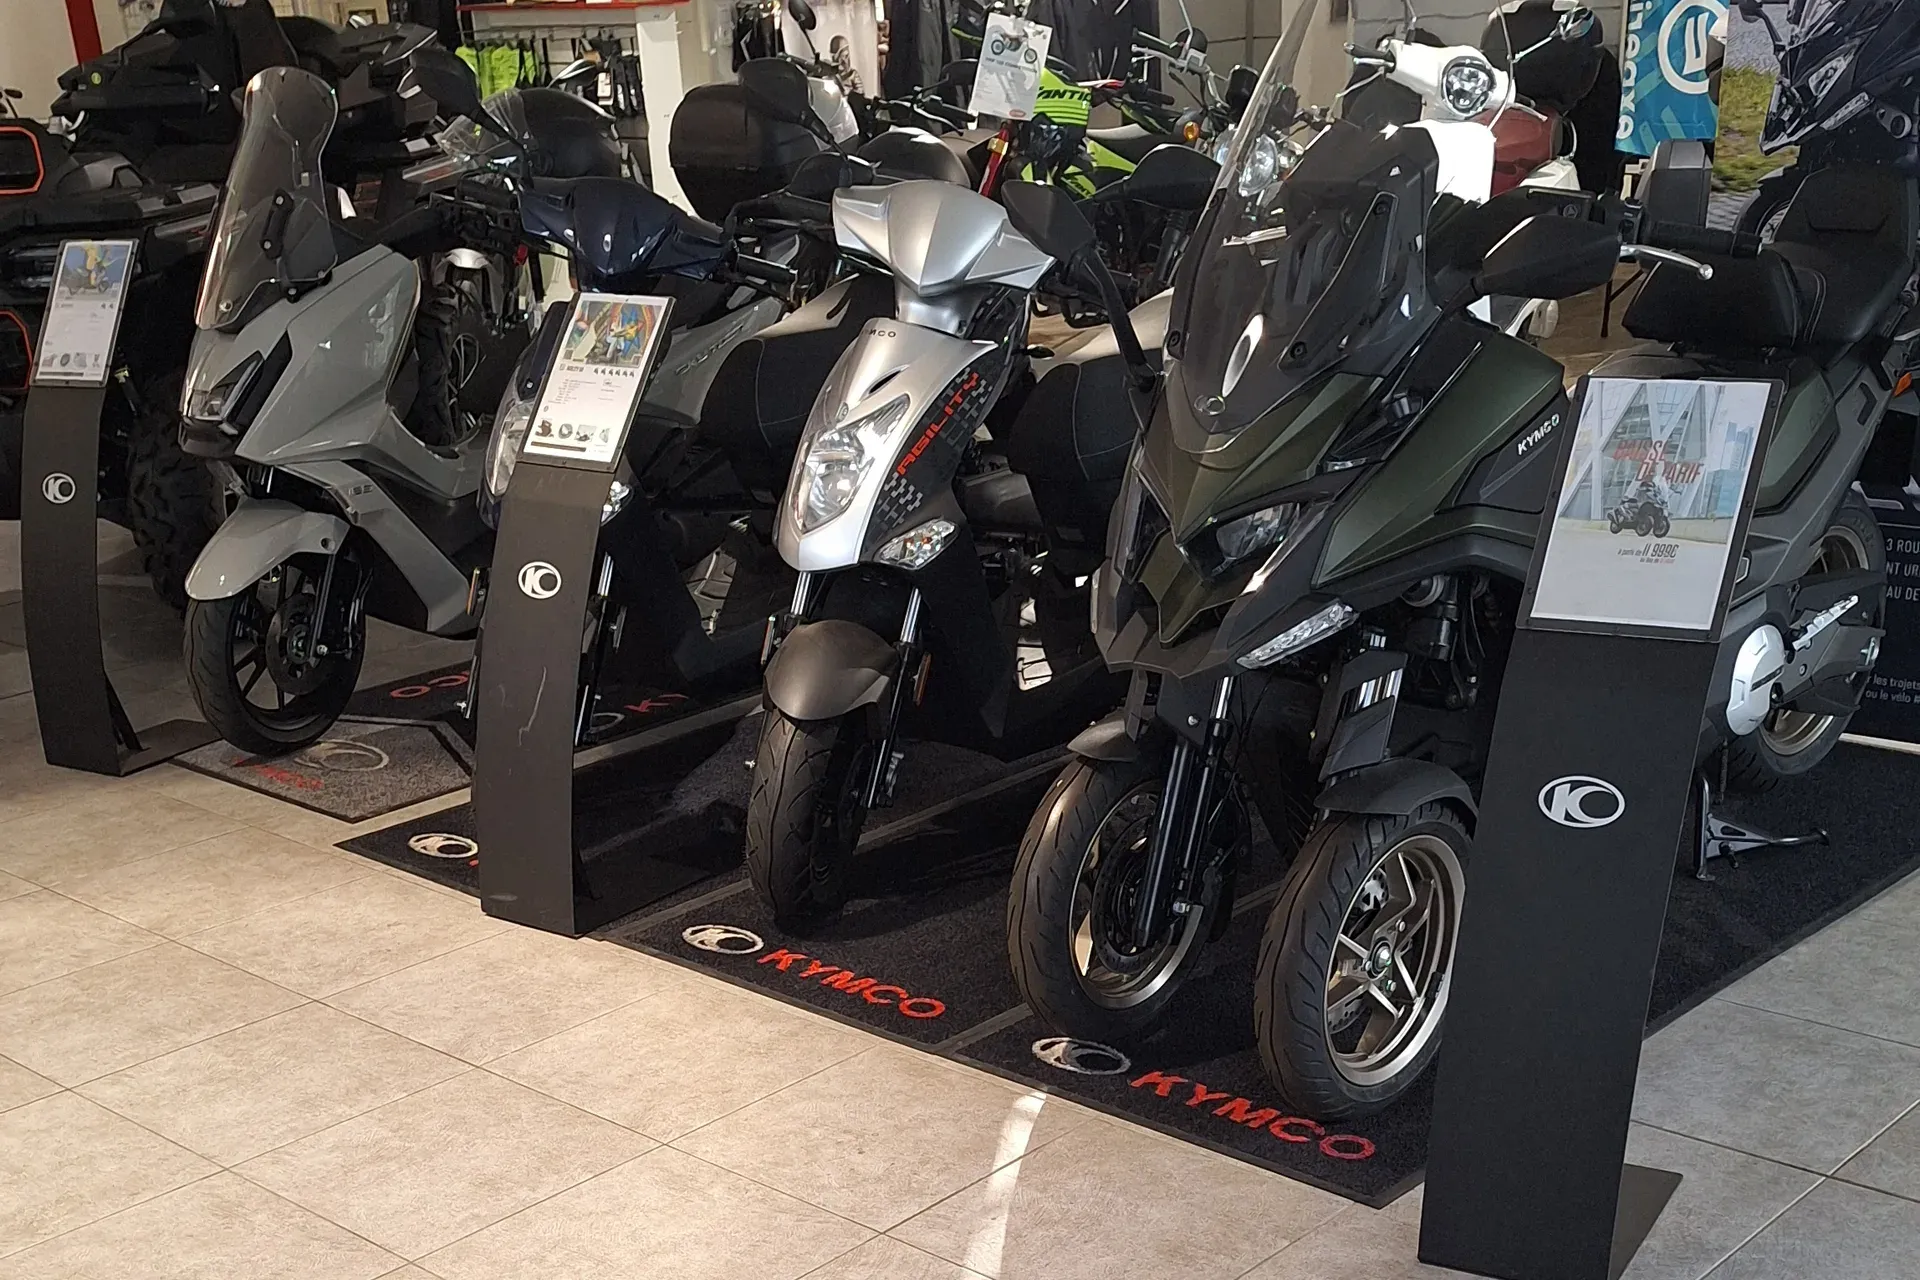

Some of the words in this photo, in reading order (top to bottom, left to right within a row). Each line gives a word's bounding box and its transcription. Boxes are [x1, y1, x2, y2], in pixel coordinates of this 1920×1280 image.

[897, 372, 979, 475] AGILITY
[1518, 413, 1560, 455] KYMCO
[1886, 538, 1893, 552] 3
[1904, 563, 1920, 578] UR
[1886, 585, 1902, 599] AU
[1873, 673, 1887, 687] les
[1865, 689, 1878, 699] ou
[1880, 688, 1889, 700] le
[757, 948, 946, 1018] KYMCO
[1129, 1071, 1376, 1160] KYMCO
